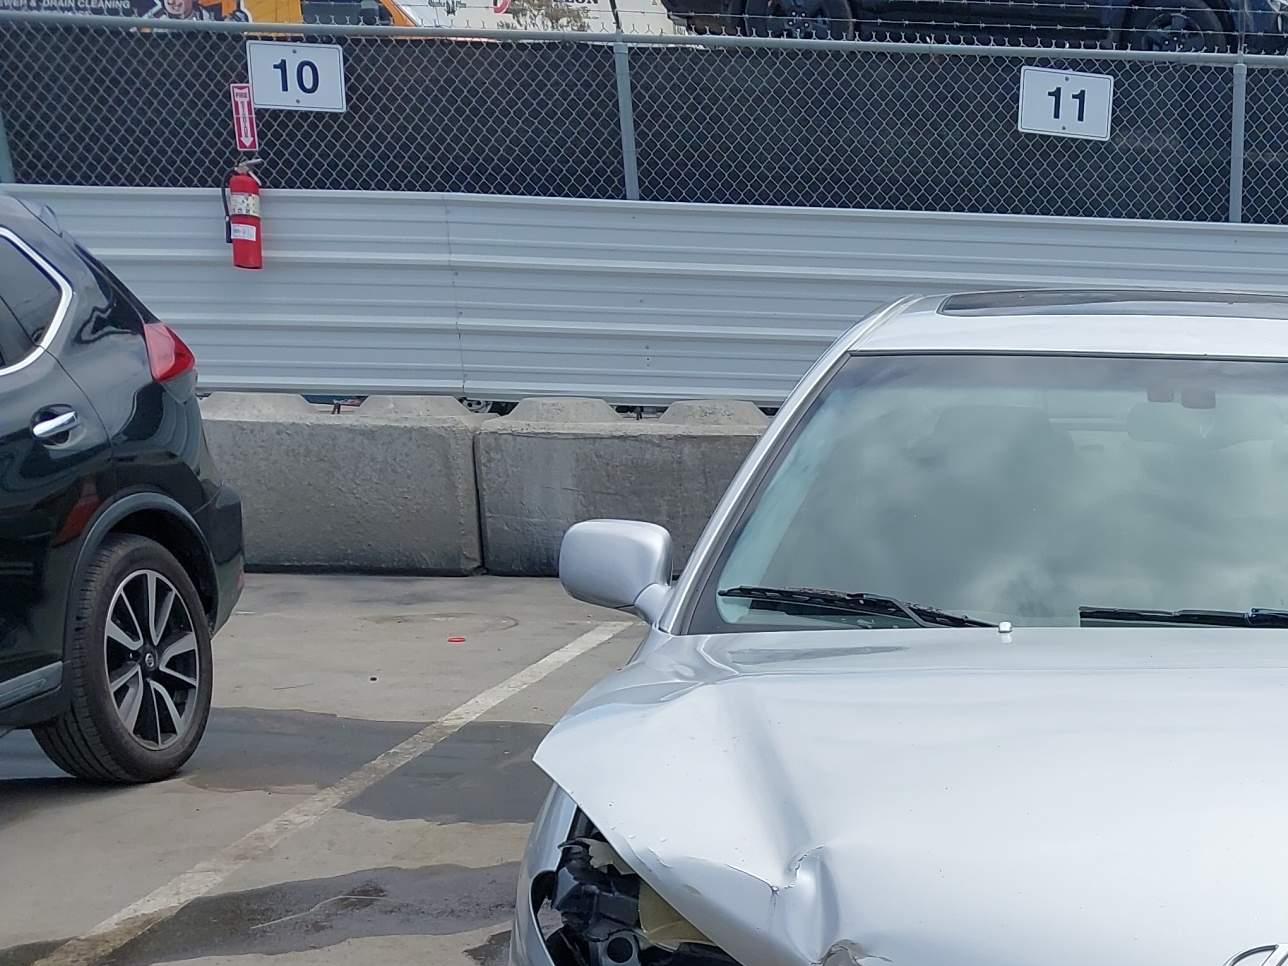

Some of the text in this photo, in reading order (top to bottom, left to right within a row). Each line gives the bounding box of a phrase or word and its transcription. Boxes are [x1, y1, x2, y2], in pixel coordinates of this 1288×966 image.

[77, 0, 130, 9] CLEANING
[273, 59, 319, 94] 10
[1047, 87, 1086, 121] 11
